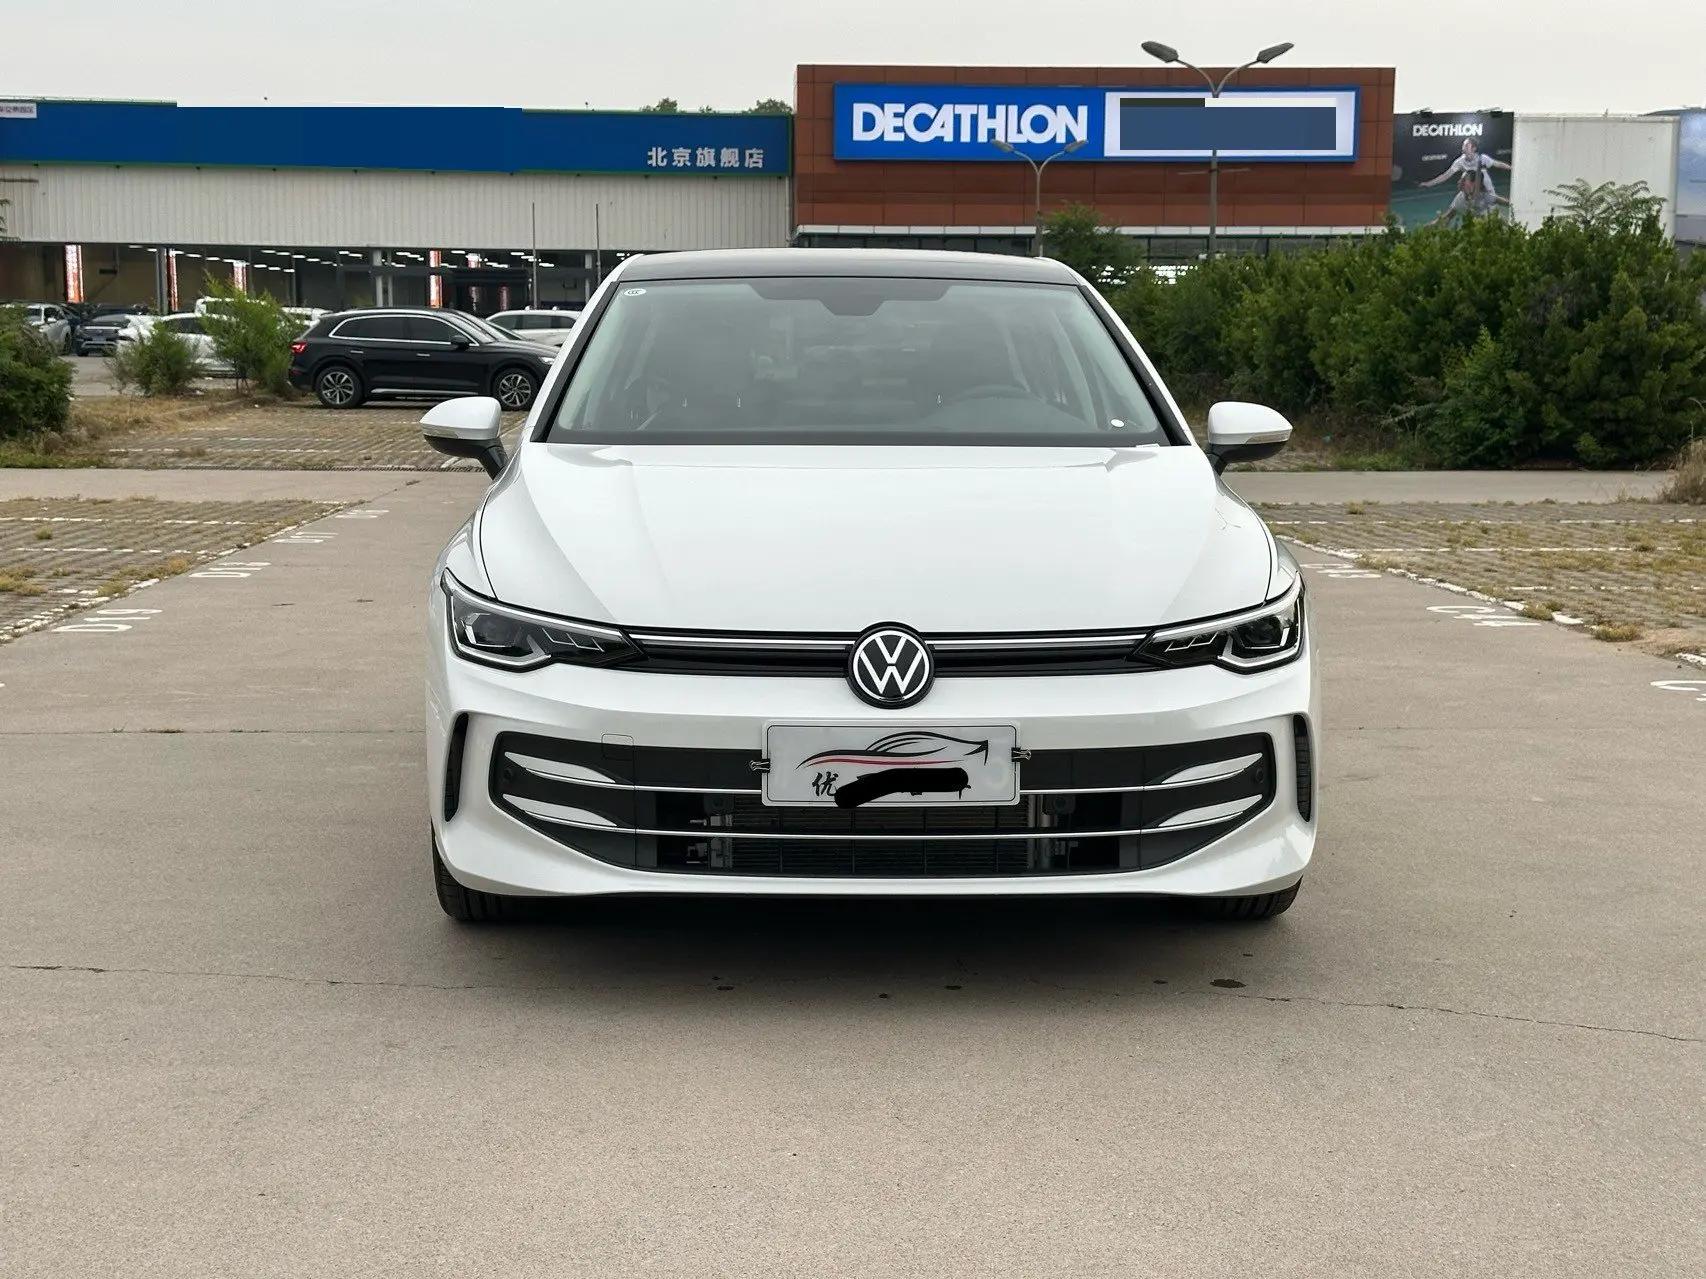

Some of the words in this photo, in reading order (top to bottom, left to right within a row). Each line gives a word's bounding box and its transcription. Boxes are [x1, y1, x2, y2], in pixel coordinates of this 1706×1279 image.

[852, 102, 1089, 144] DECATHLON
[1412, 122, 1484, 137] DECATHLON
[647, 146, 765, 169] 北京旗舰店
